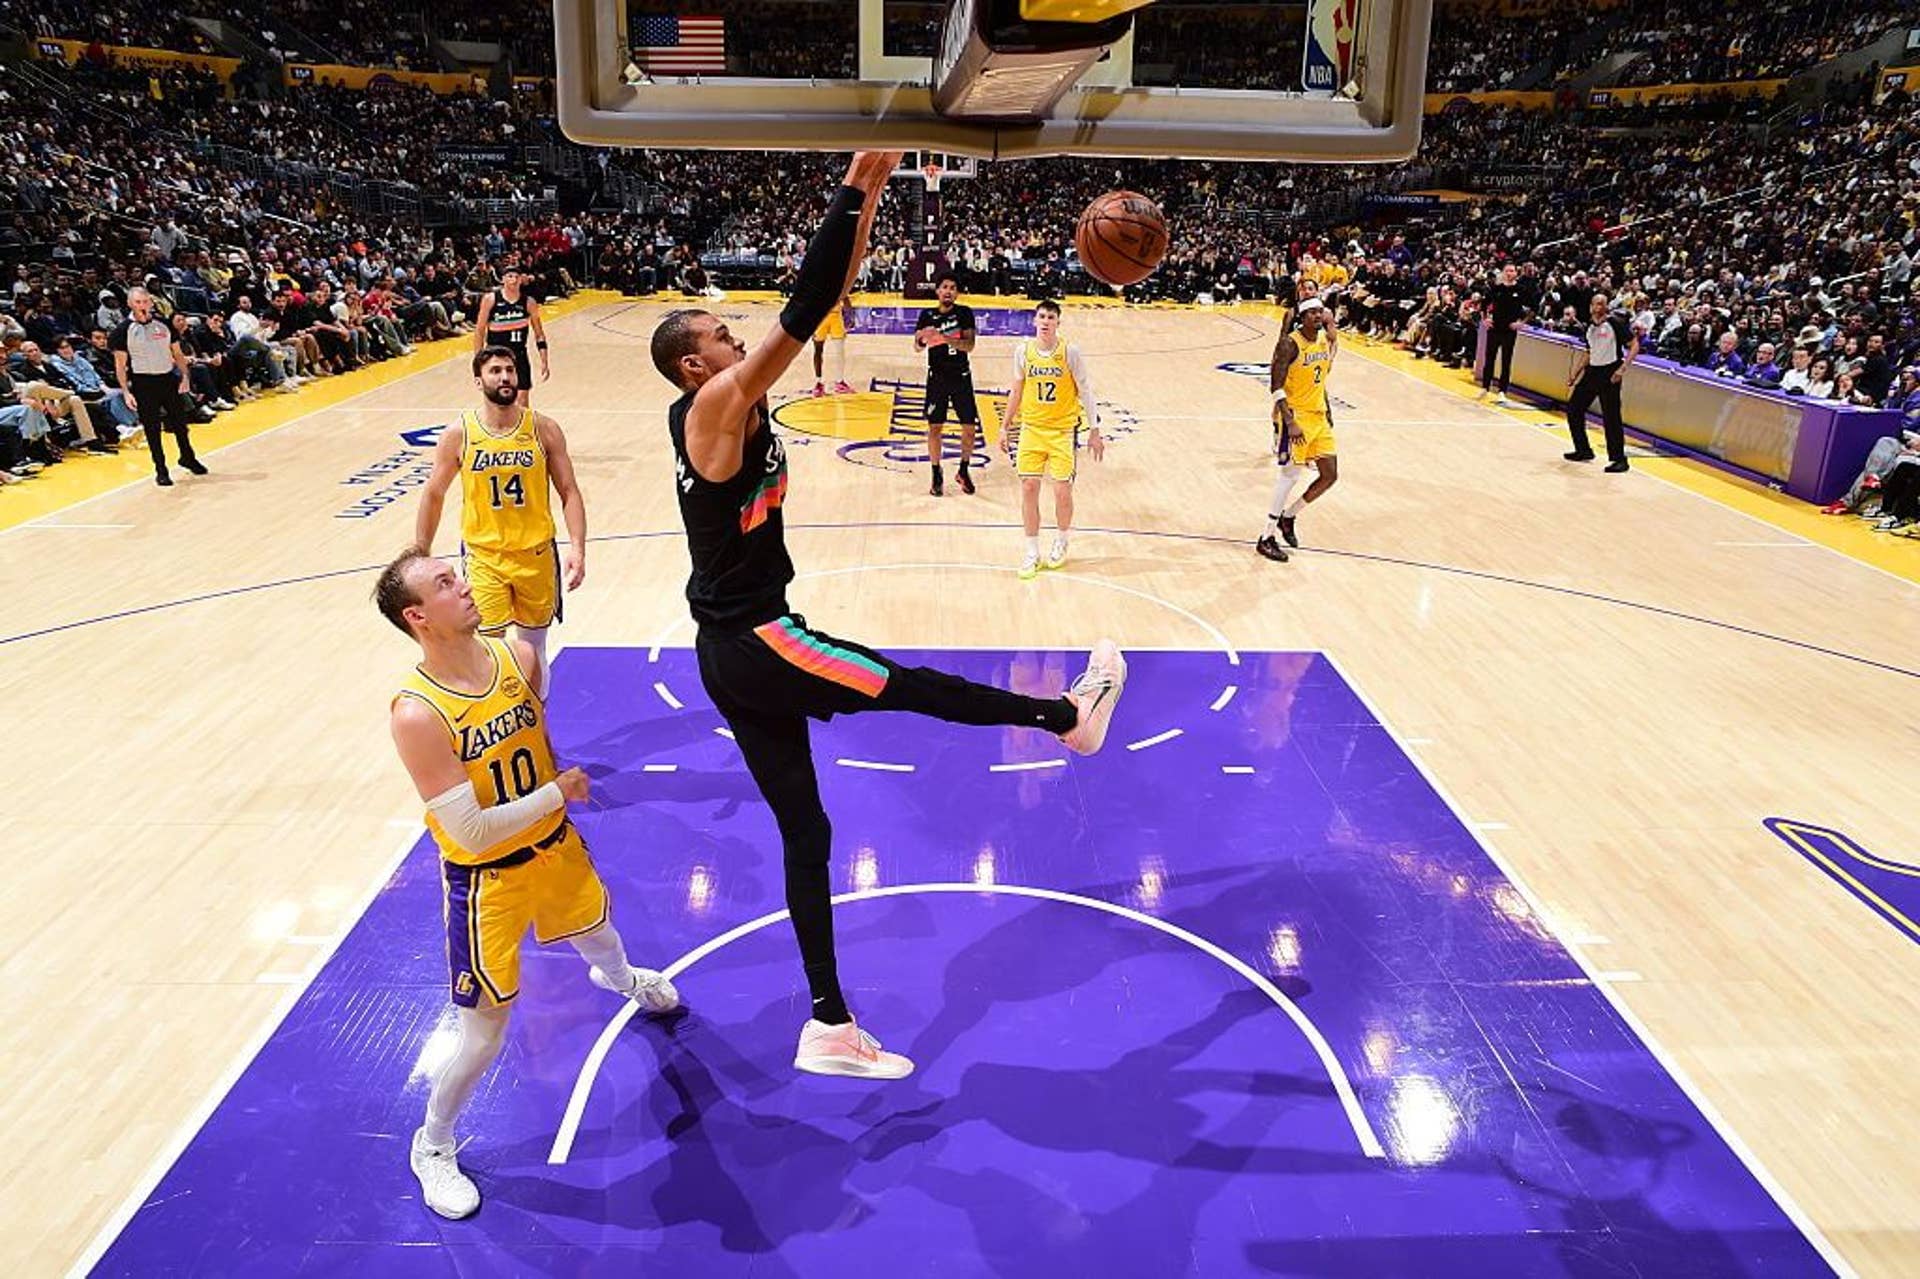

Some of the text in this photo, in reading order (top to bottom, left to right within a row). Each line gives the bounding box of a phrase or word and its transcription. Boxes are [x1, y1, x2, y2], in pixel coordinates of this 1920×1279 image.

[1308, 65, 1333, 85] NBA
[510, 331, 522, 342] 11
[1037, 381, 1057, 402] 12
[471, 449, 535, 471] LAKERS
[489, 473, 525, 507] 14
[459, 699, 538, 762] LAKERS
[488, 747, 538, 807] 10
